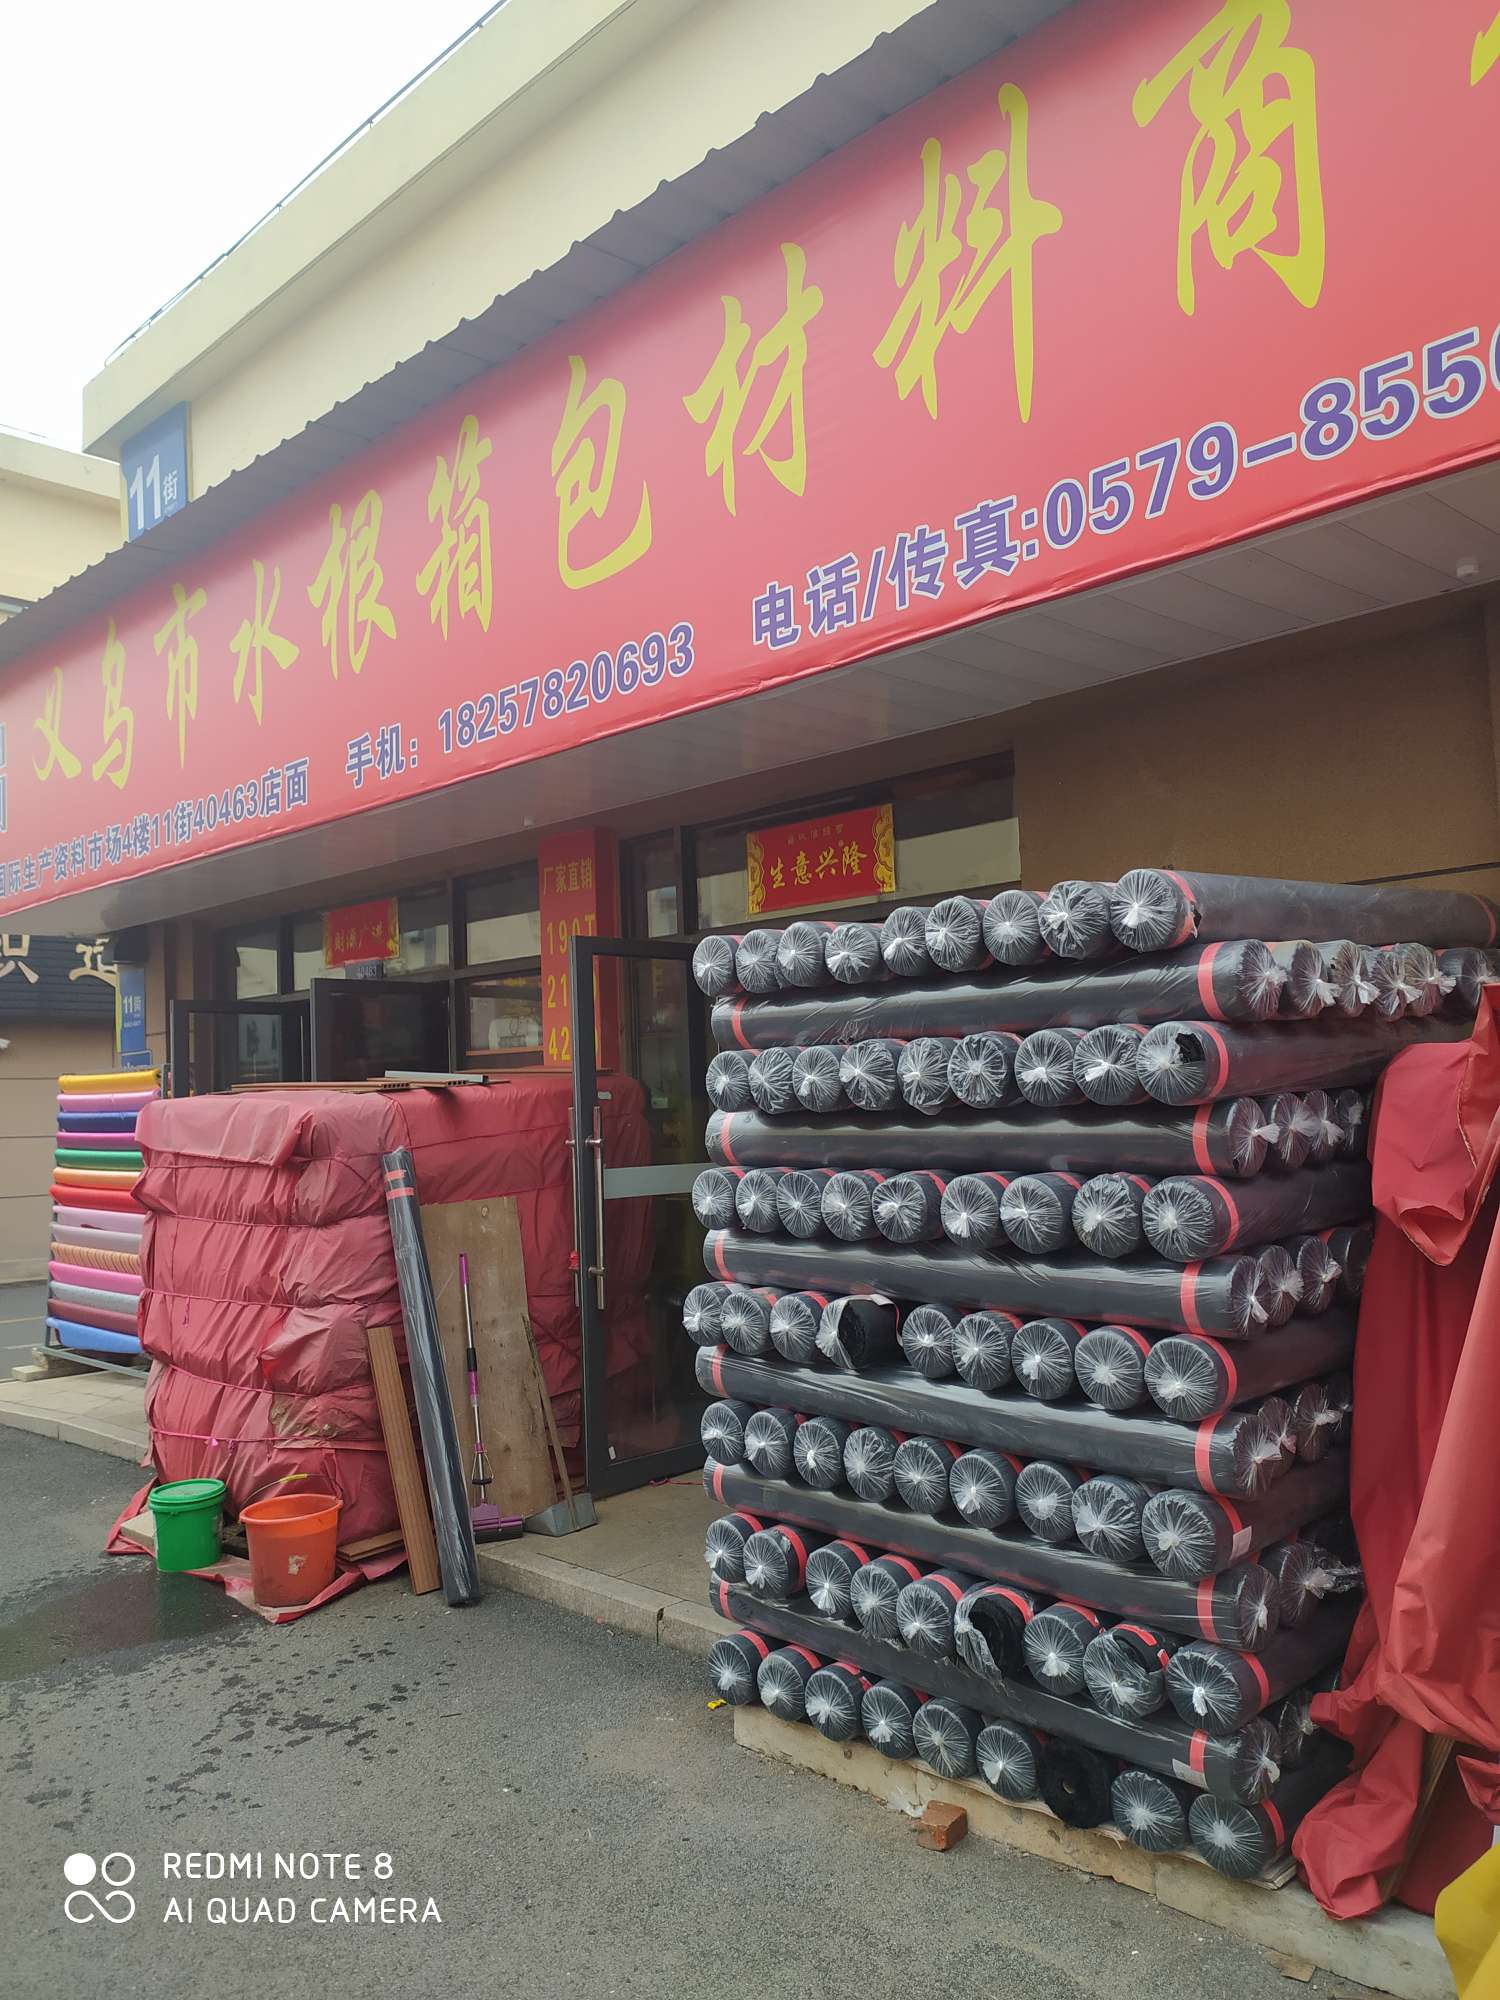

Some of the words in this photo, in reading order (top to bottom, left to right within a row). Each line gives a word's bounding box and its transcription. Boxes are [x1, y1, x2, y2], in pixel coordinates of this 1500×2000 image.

[32, 0, 1500, 787] 义乌市水根箱包材料商
[129, 453, 178, 530] 11街
[752, 325, 1500, 651] 电话/传真:0579-855
[543, 856, 593, 895] 厂家直销
[770, 840, 868, 889] 生意兴隆
